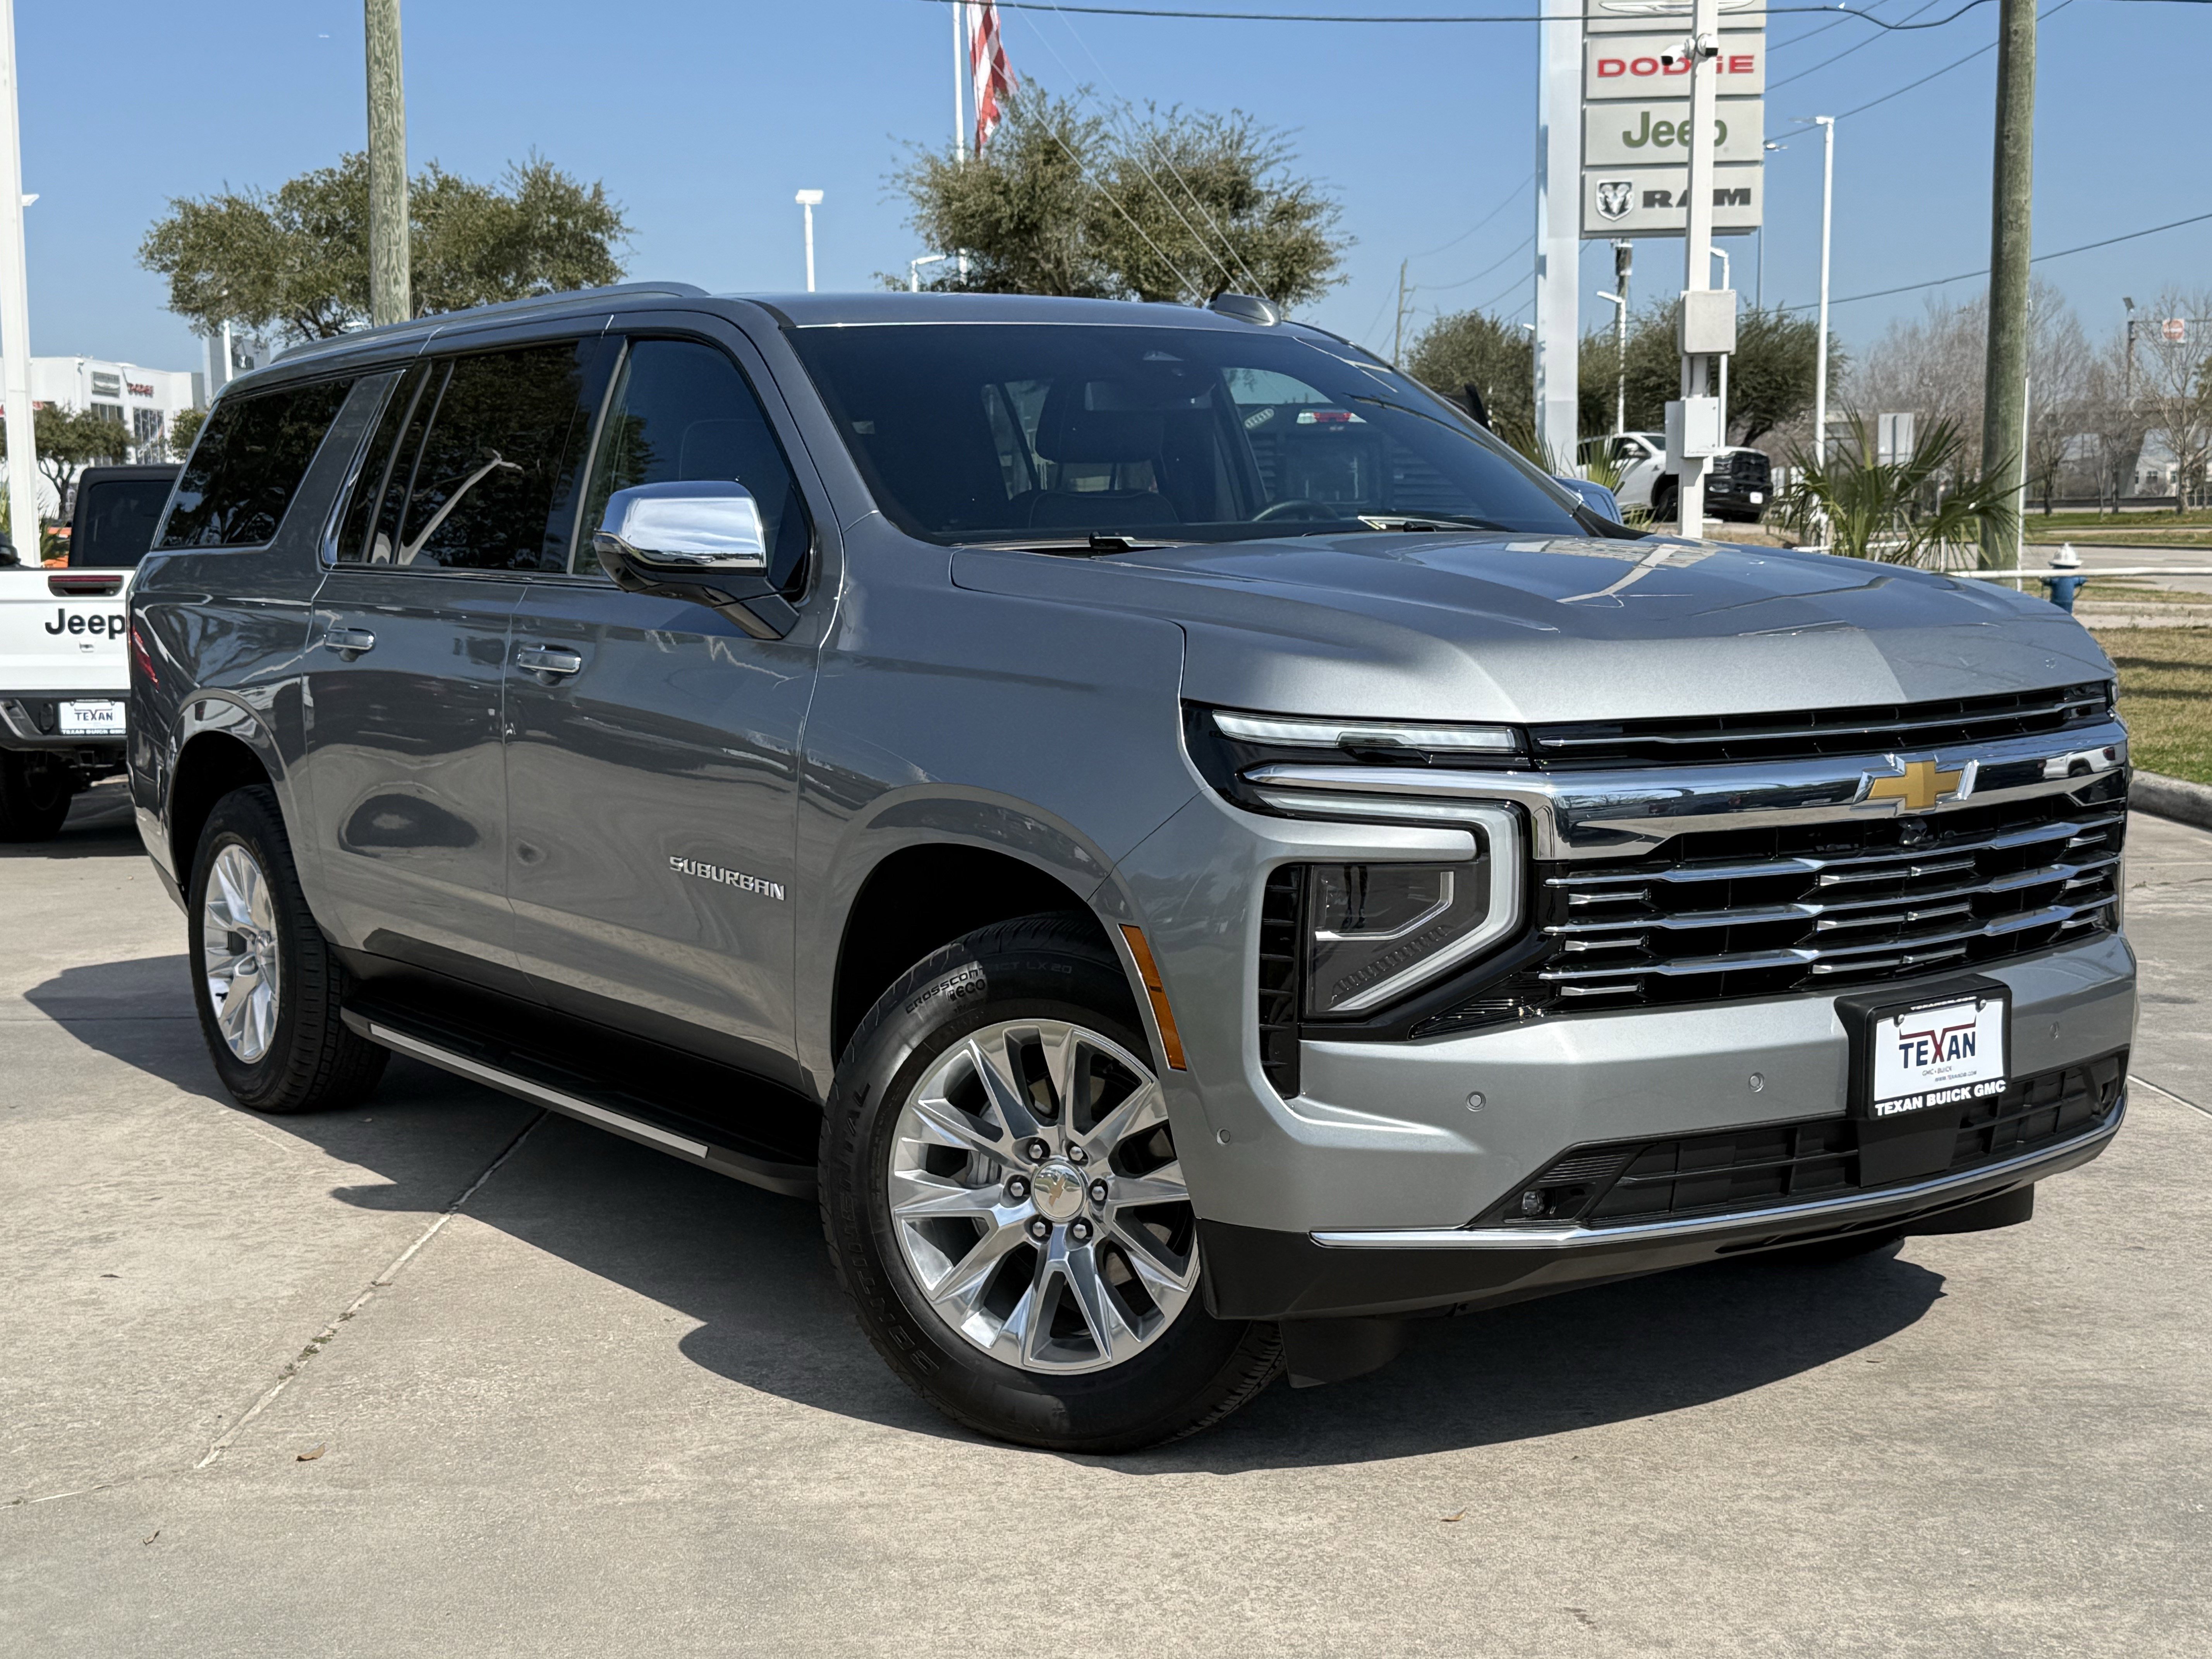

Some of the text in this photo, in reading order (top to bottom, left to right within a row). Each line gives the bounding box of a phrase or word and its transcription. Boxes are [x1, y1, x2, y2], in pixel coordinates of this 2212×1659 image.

[45, 608, 125, 640] Jeep
[74, 709, 113, 721] TEXAN
[670, 856, 785, 901] SUBURBAN
[1899, 1028, 1976, 1068] TEXAN
[1875, 1080, 2006, 1116] TEXAN BUICK GMC
